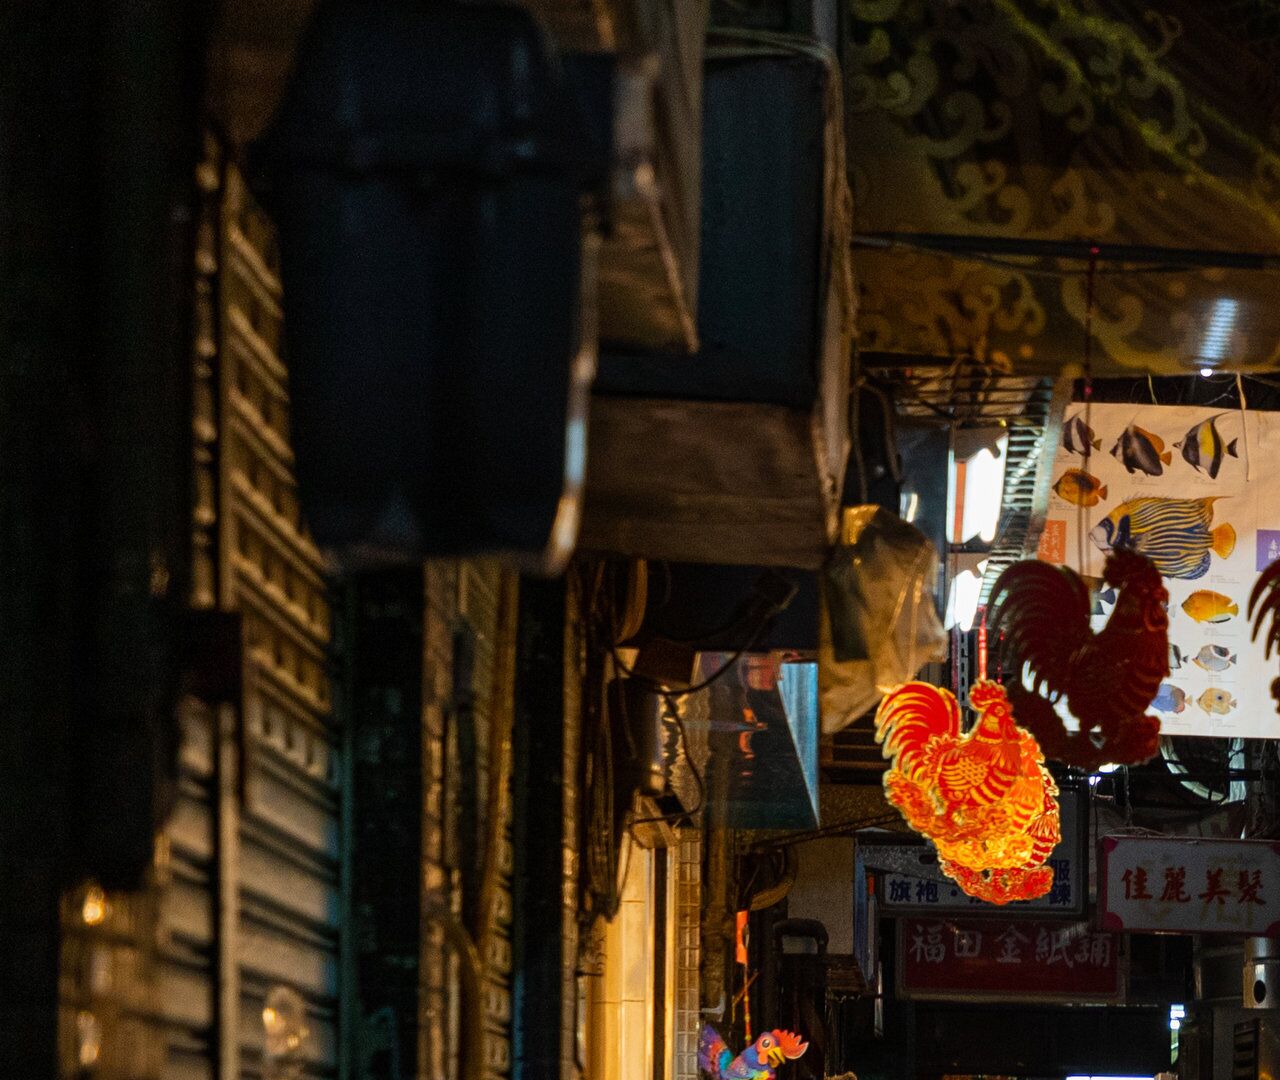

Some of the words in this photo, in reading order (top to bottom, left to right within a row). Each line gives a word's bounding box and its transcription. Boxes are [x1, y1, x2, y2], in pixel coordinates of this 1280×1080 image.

[889, 879, 938, 903] 旗袍
[1121, 867, 1266, 905] 佳麗美髮
